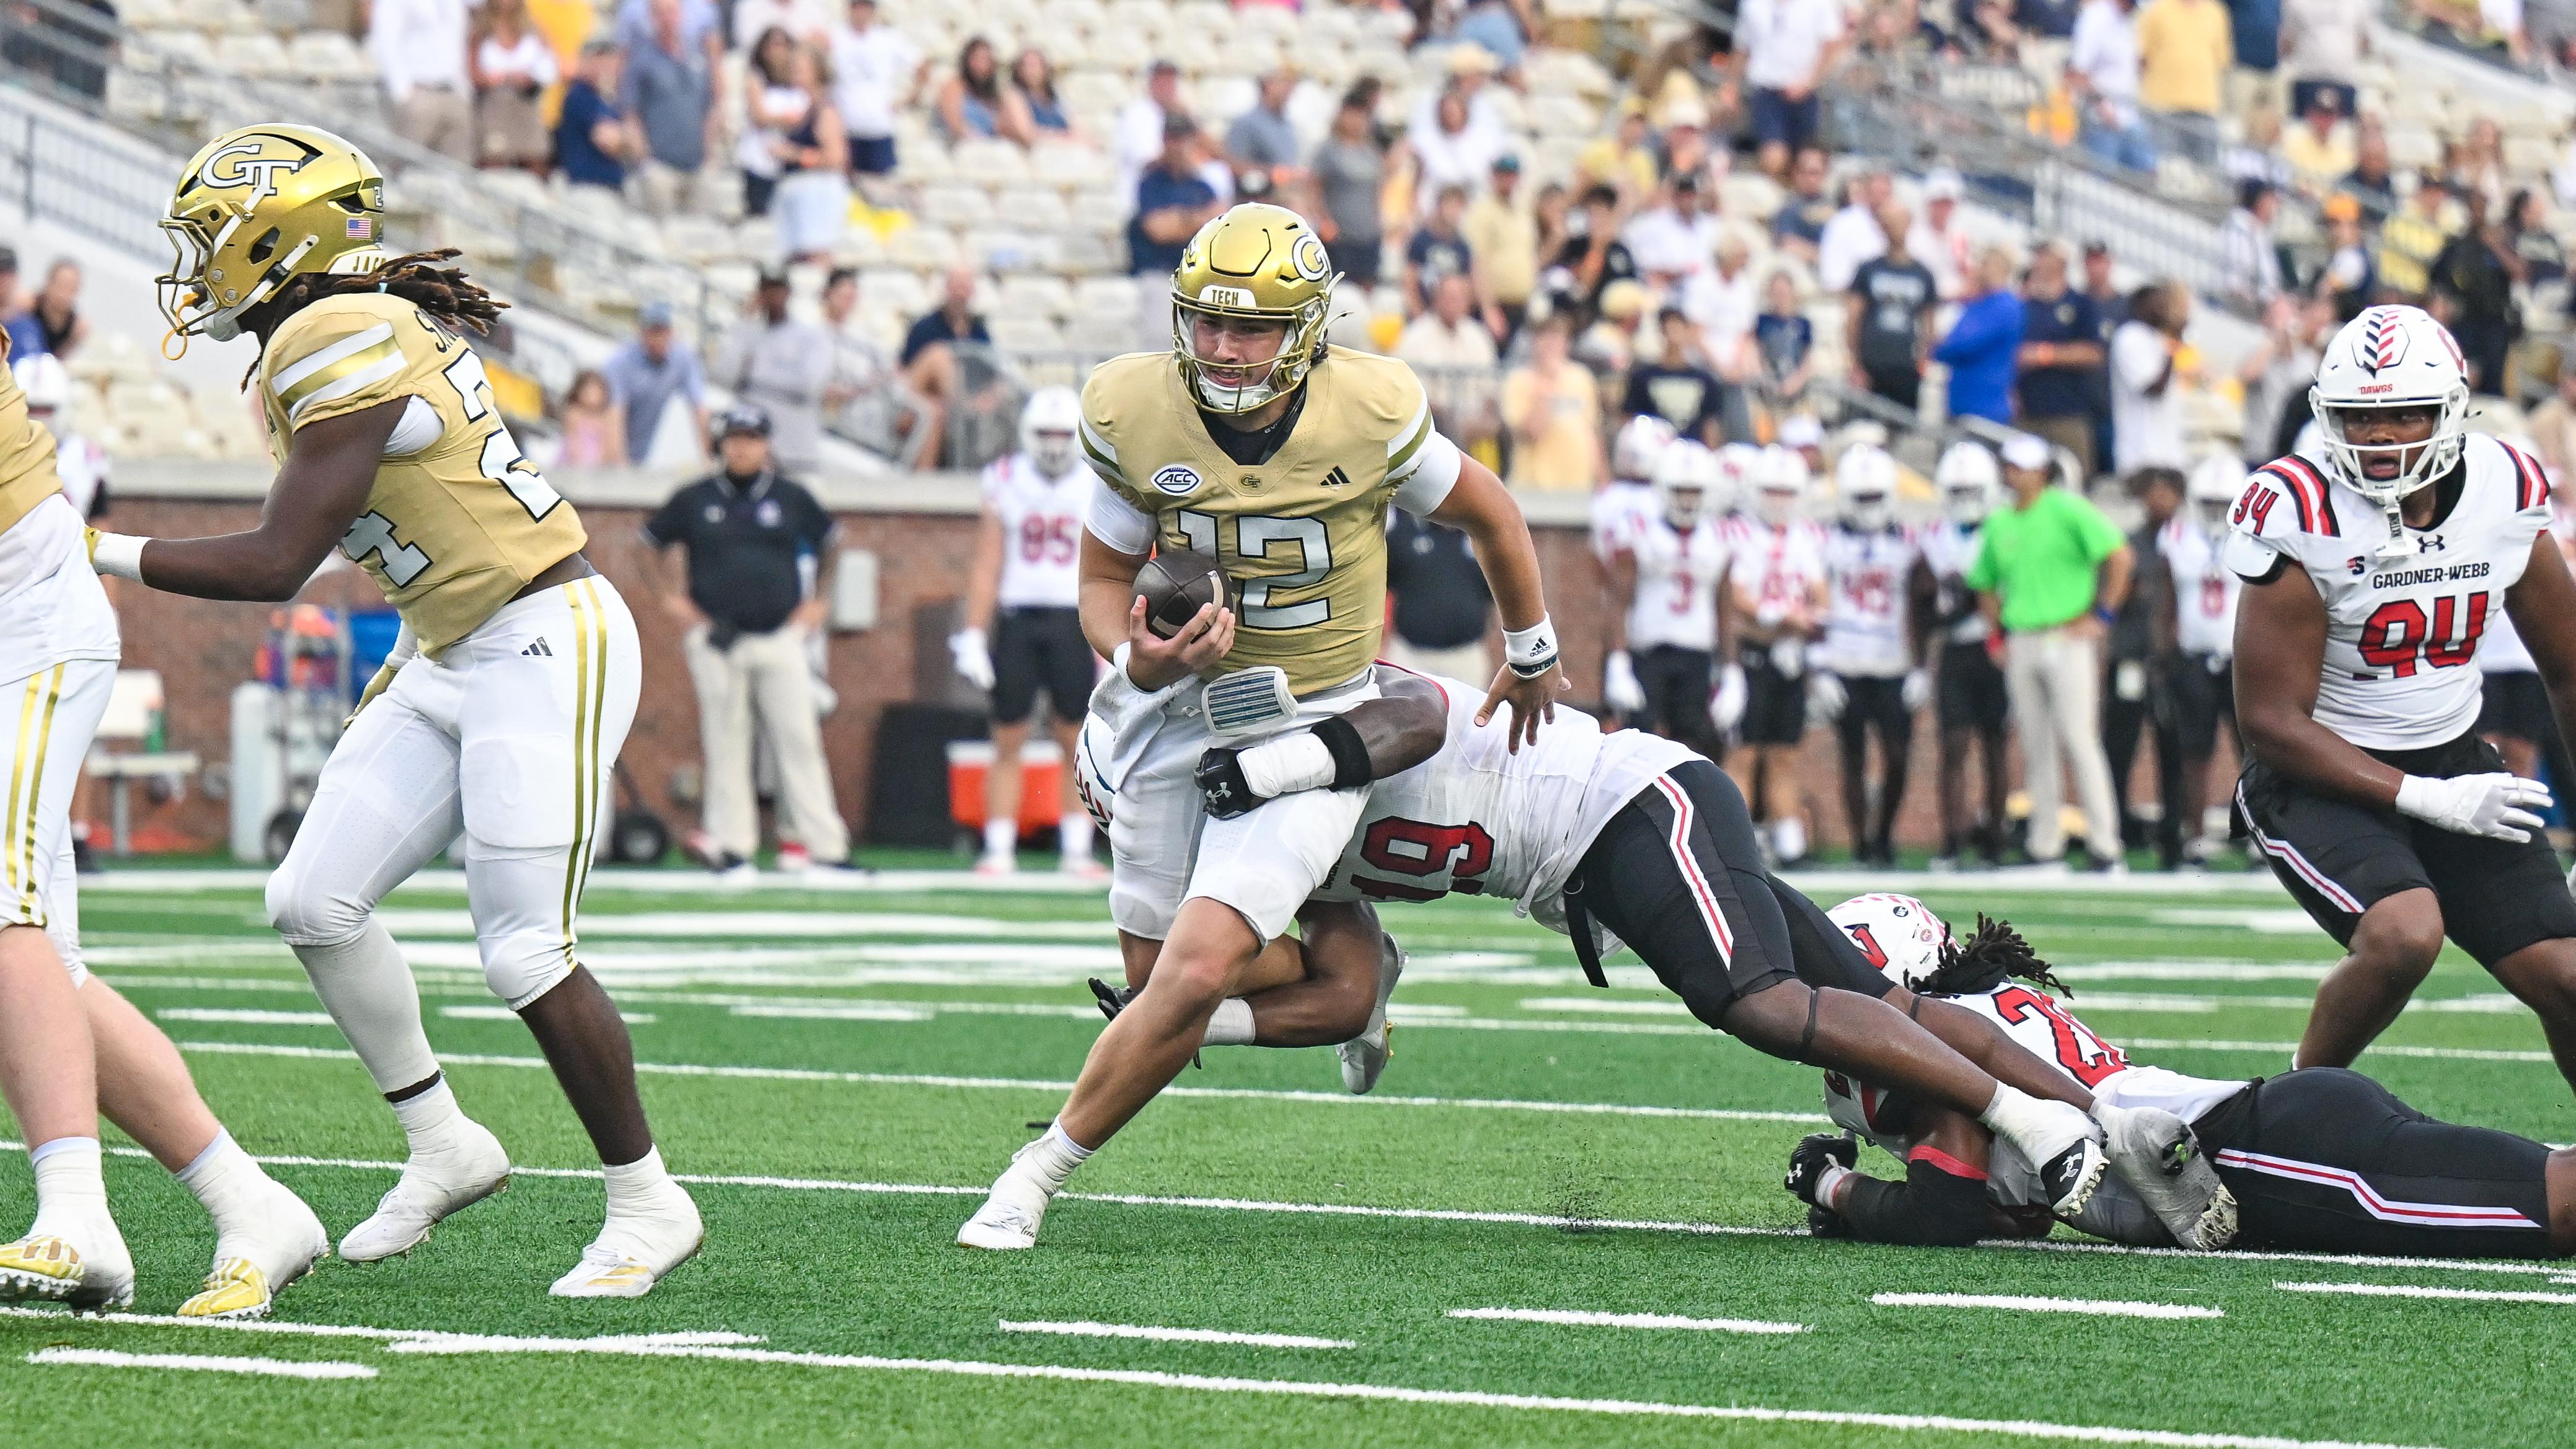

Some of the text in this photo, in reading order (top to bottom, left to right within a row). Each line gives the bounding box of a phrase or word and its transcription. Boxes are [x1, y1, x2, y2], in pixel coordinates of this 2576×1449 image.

[201, 144, 301, 196] GT
[1212, 289, 1238, 306] TECH
[2359, 384, 2393, 395] DAWGS
[1161, 473, 1193, 483] ACC
[2233, 482, 2280, 537] 94
[1021, 514, 1077, 565] 85
[2373, 562, 2490, 589] GARDNER-WEBB
[2352, 591, 2489, 680] 94
[1530, 645, 1551, 658] adidas
